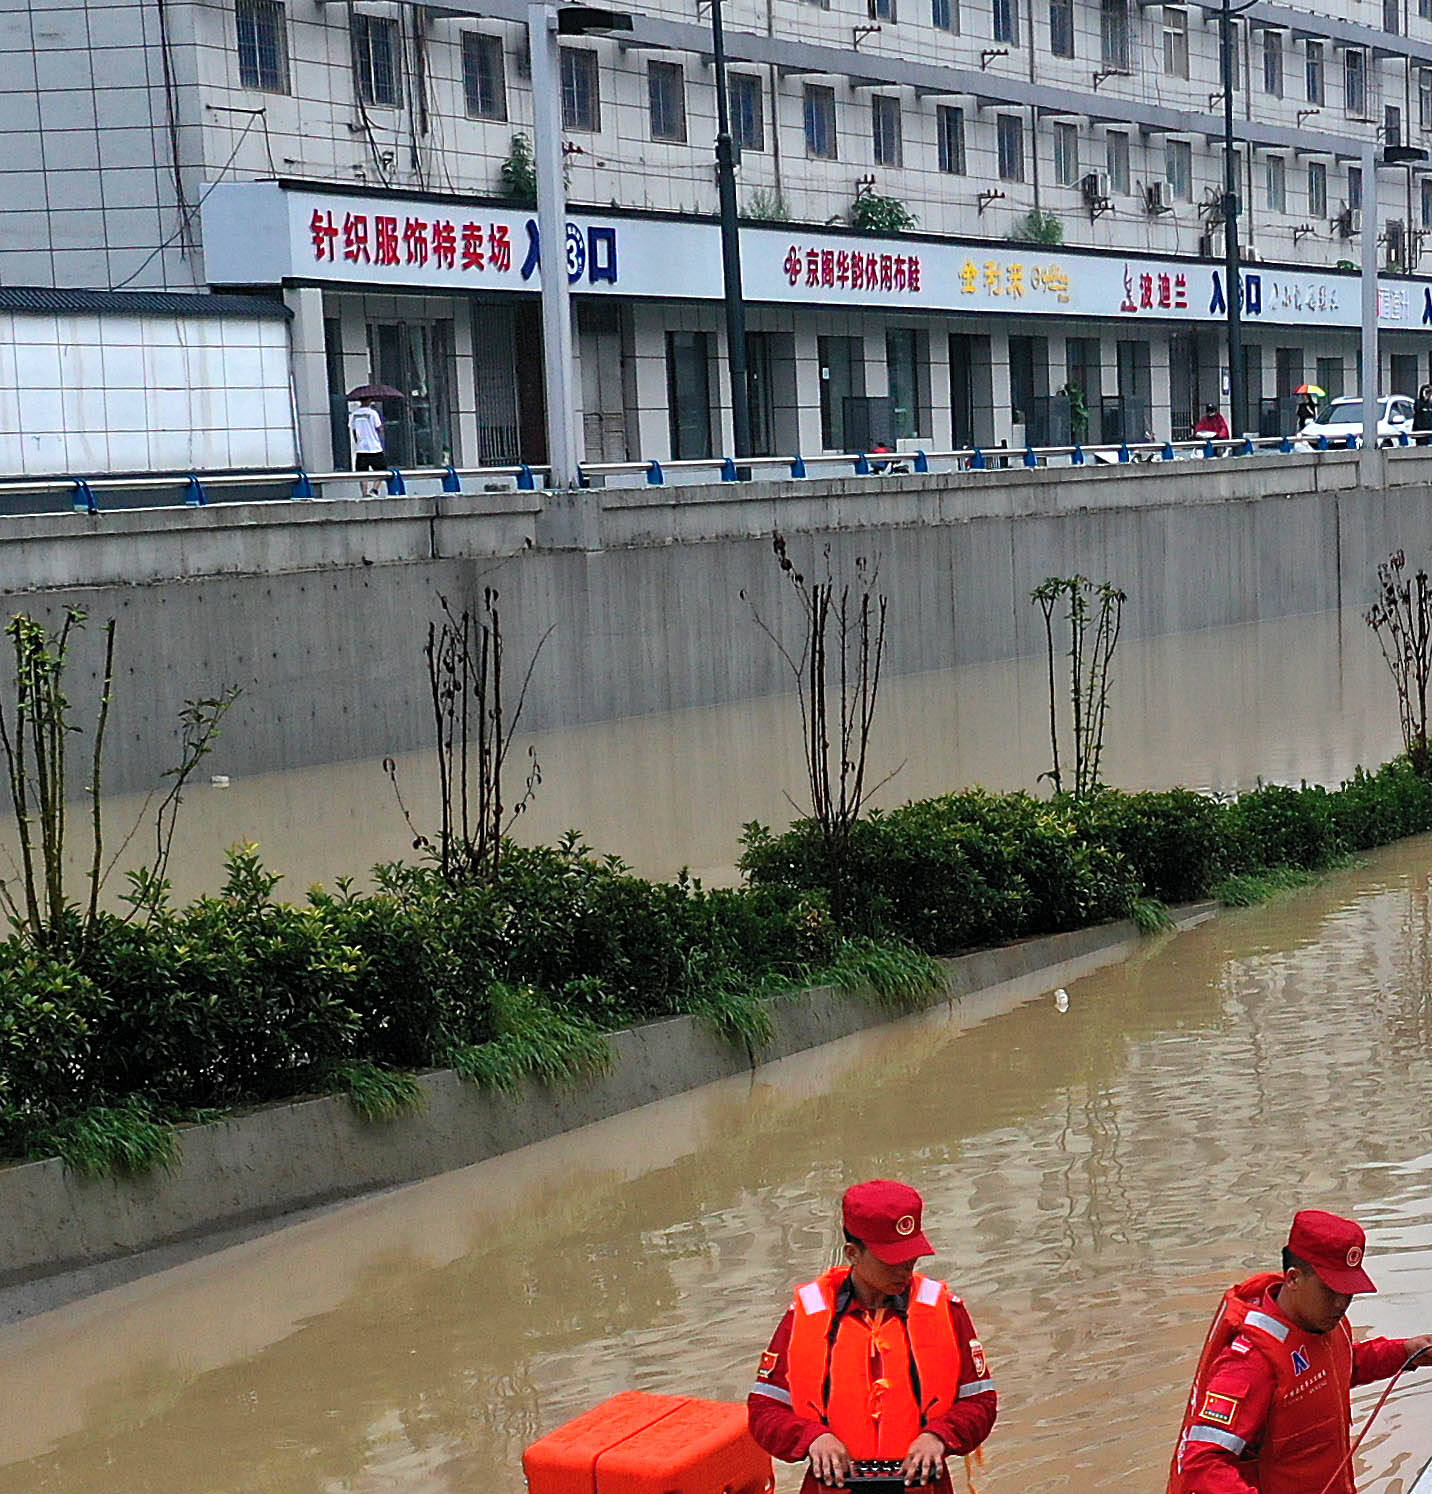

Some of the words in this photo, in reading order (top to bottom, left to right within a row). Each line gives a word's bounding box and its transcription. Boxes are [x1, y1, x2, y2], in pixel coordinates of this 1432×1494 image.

[310, 209, 512, 273] 针织服饰特卖场
[1139, 272, 1188, 310] 波迪兰
